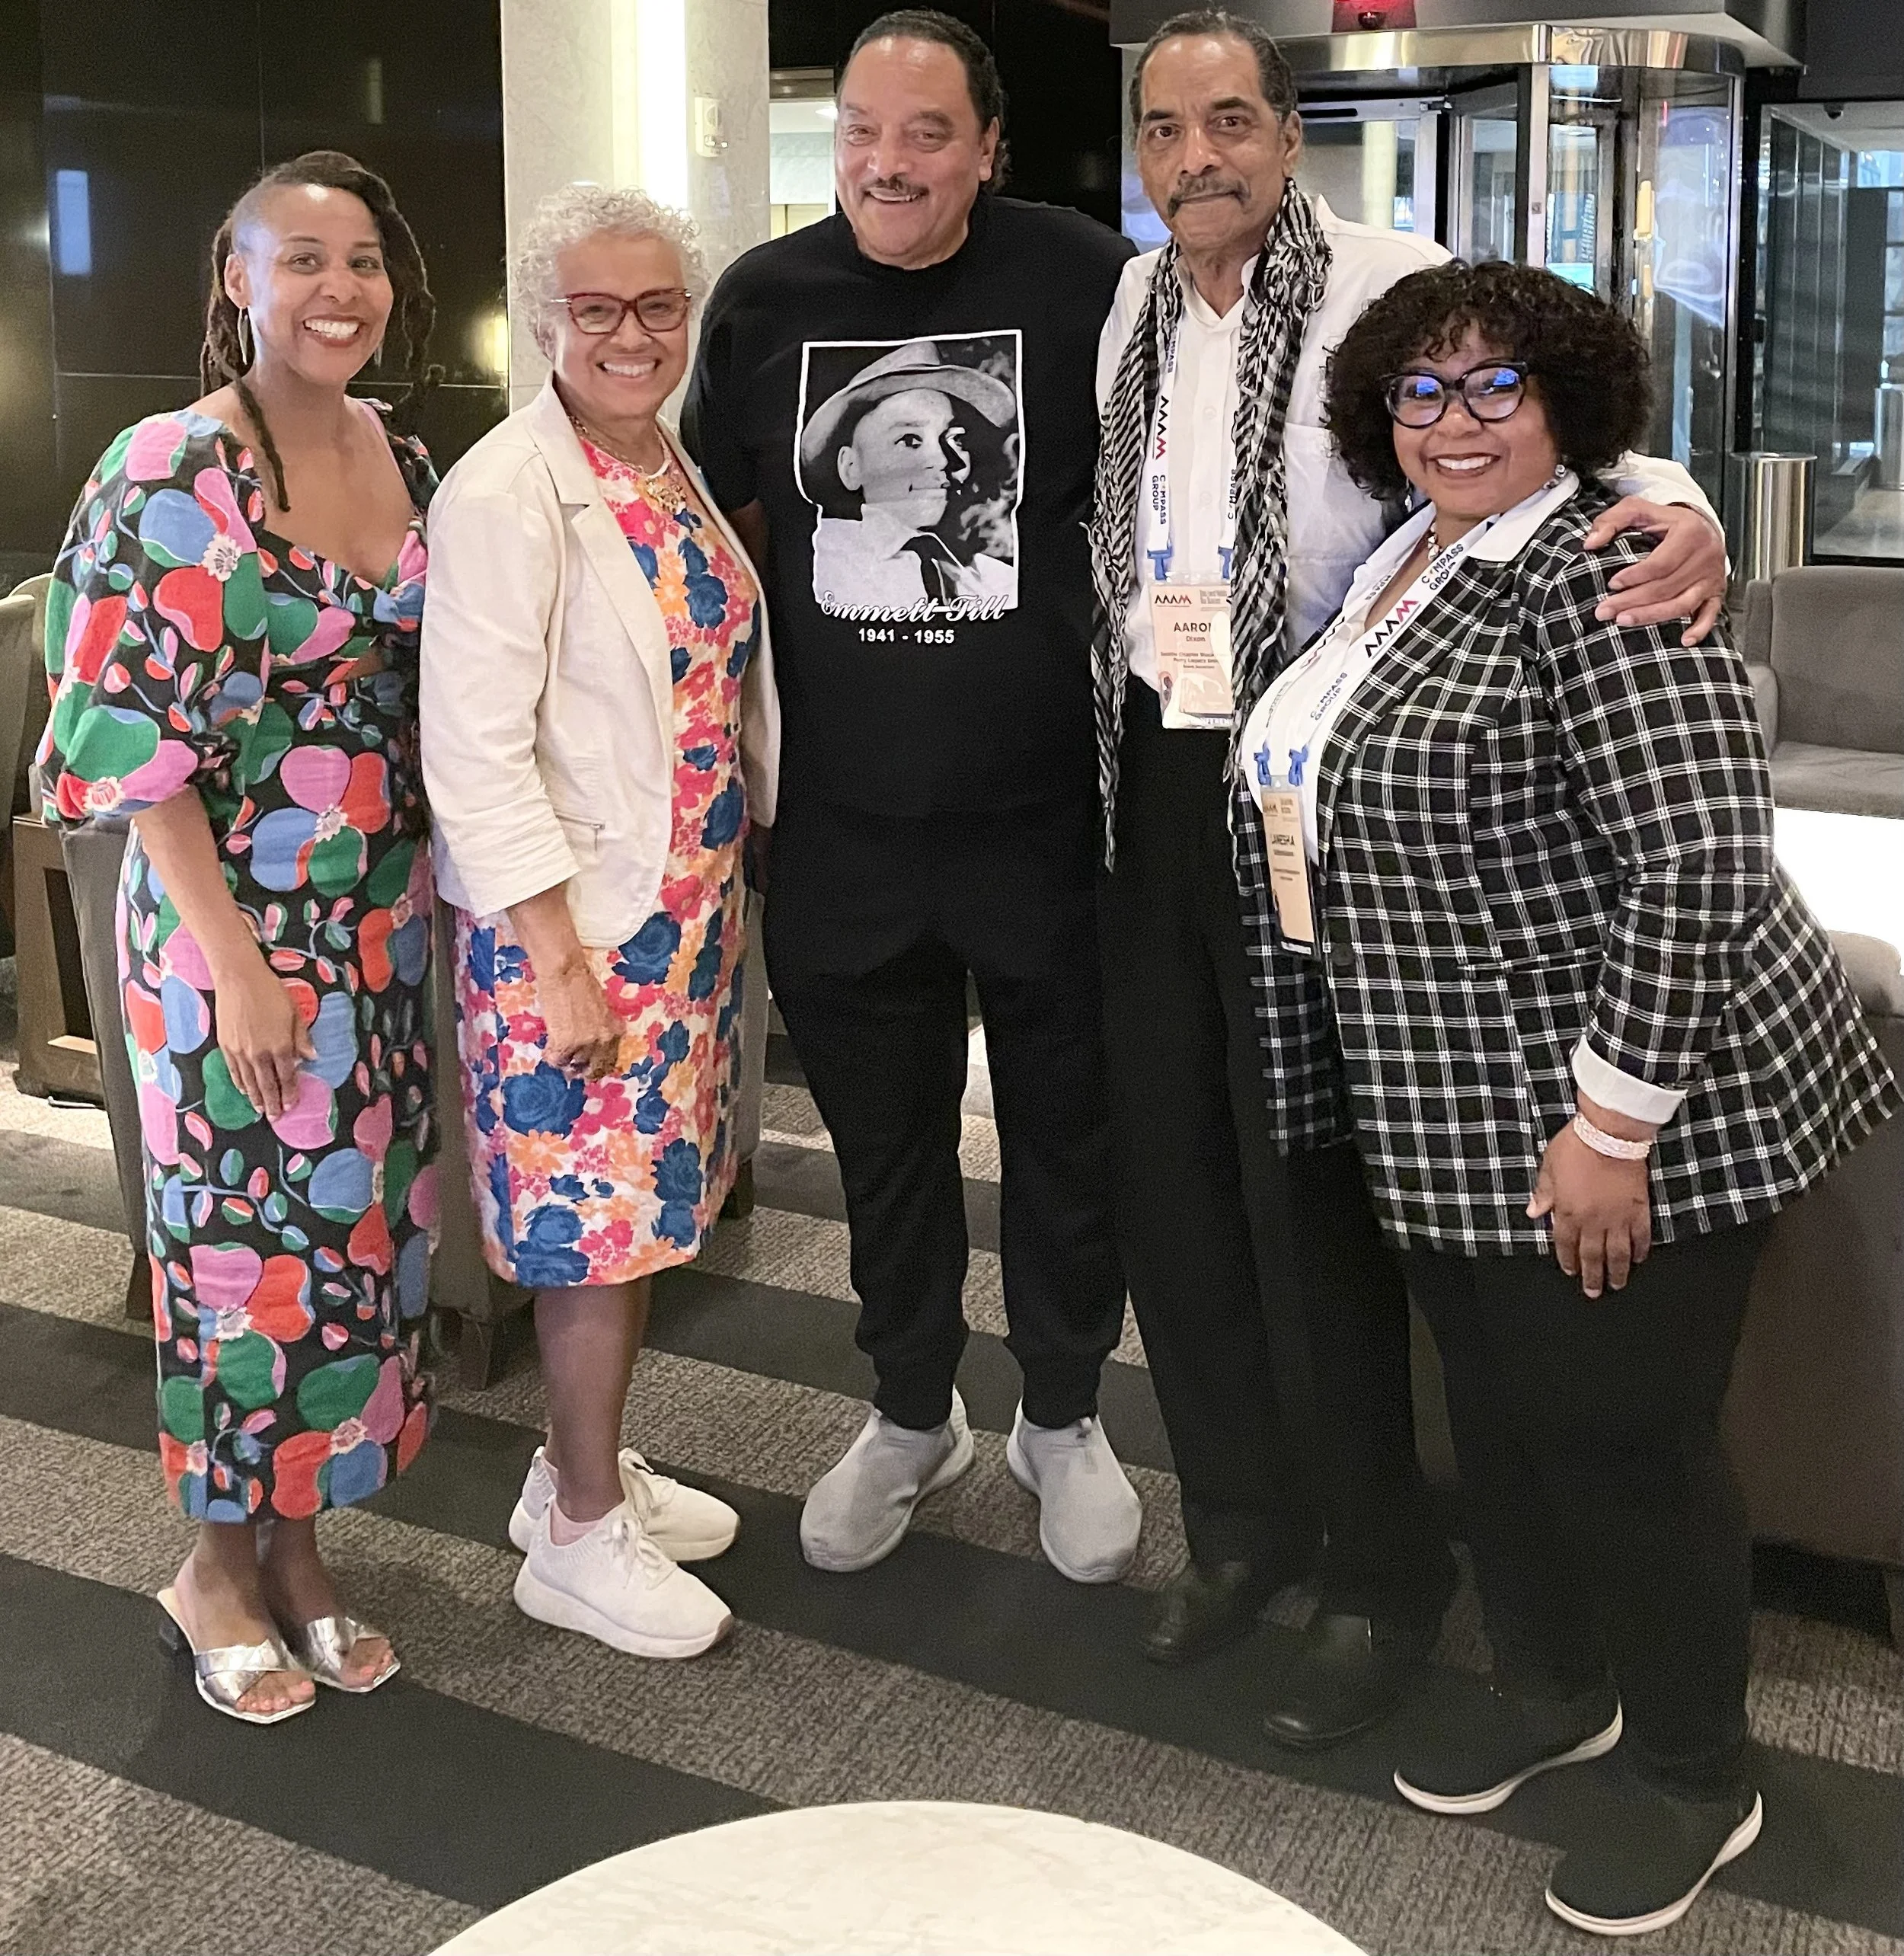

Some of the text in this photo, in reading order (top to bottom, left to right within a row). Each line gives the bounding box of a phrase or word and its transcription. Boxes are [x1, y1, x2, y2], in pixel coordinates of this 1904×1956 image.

[821, 590, 1009, 622] Emmett Till
[858, 628, 896, 642] 1941
[914, 629, 955, 644] 1955
[1315, 687, 1341, 721] GROUP
